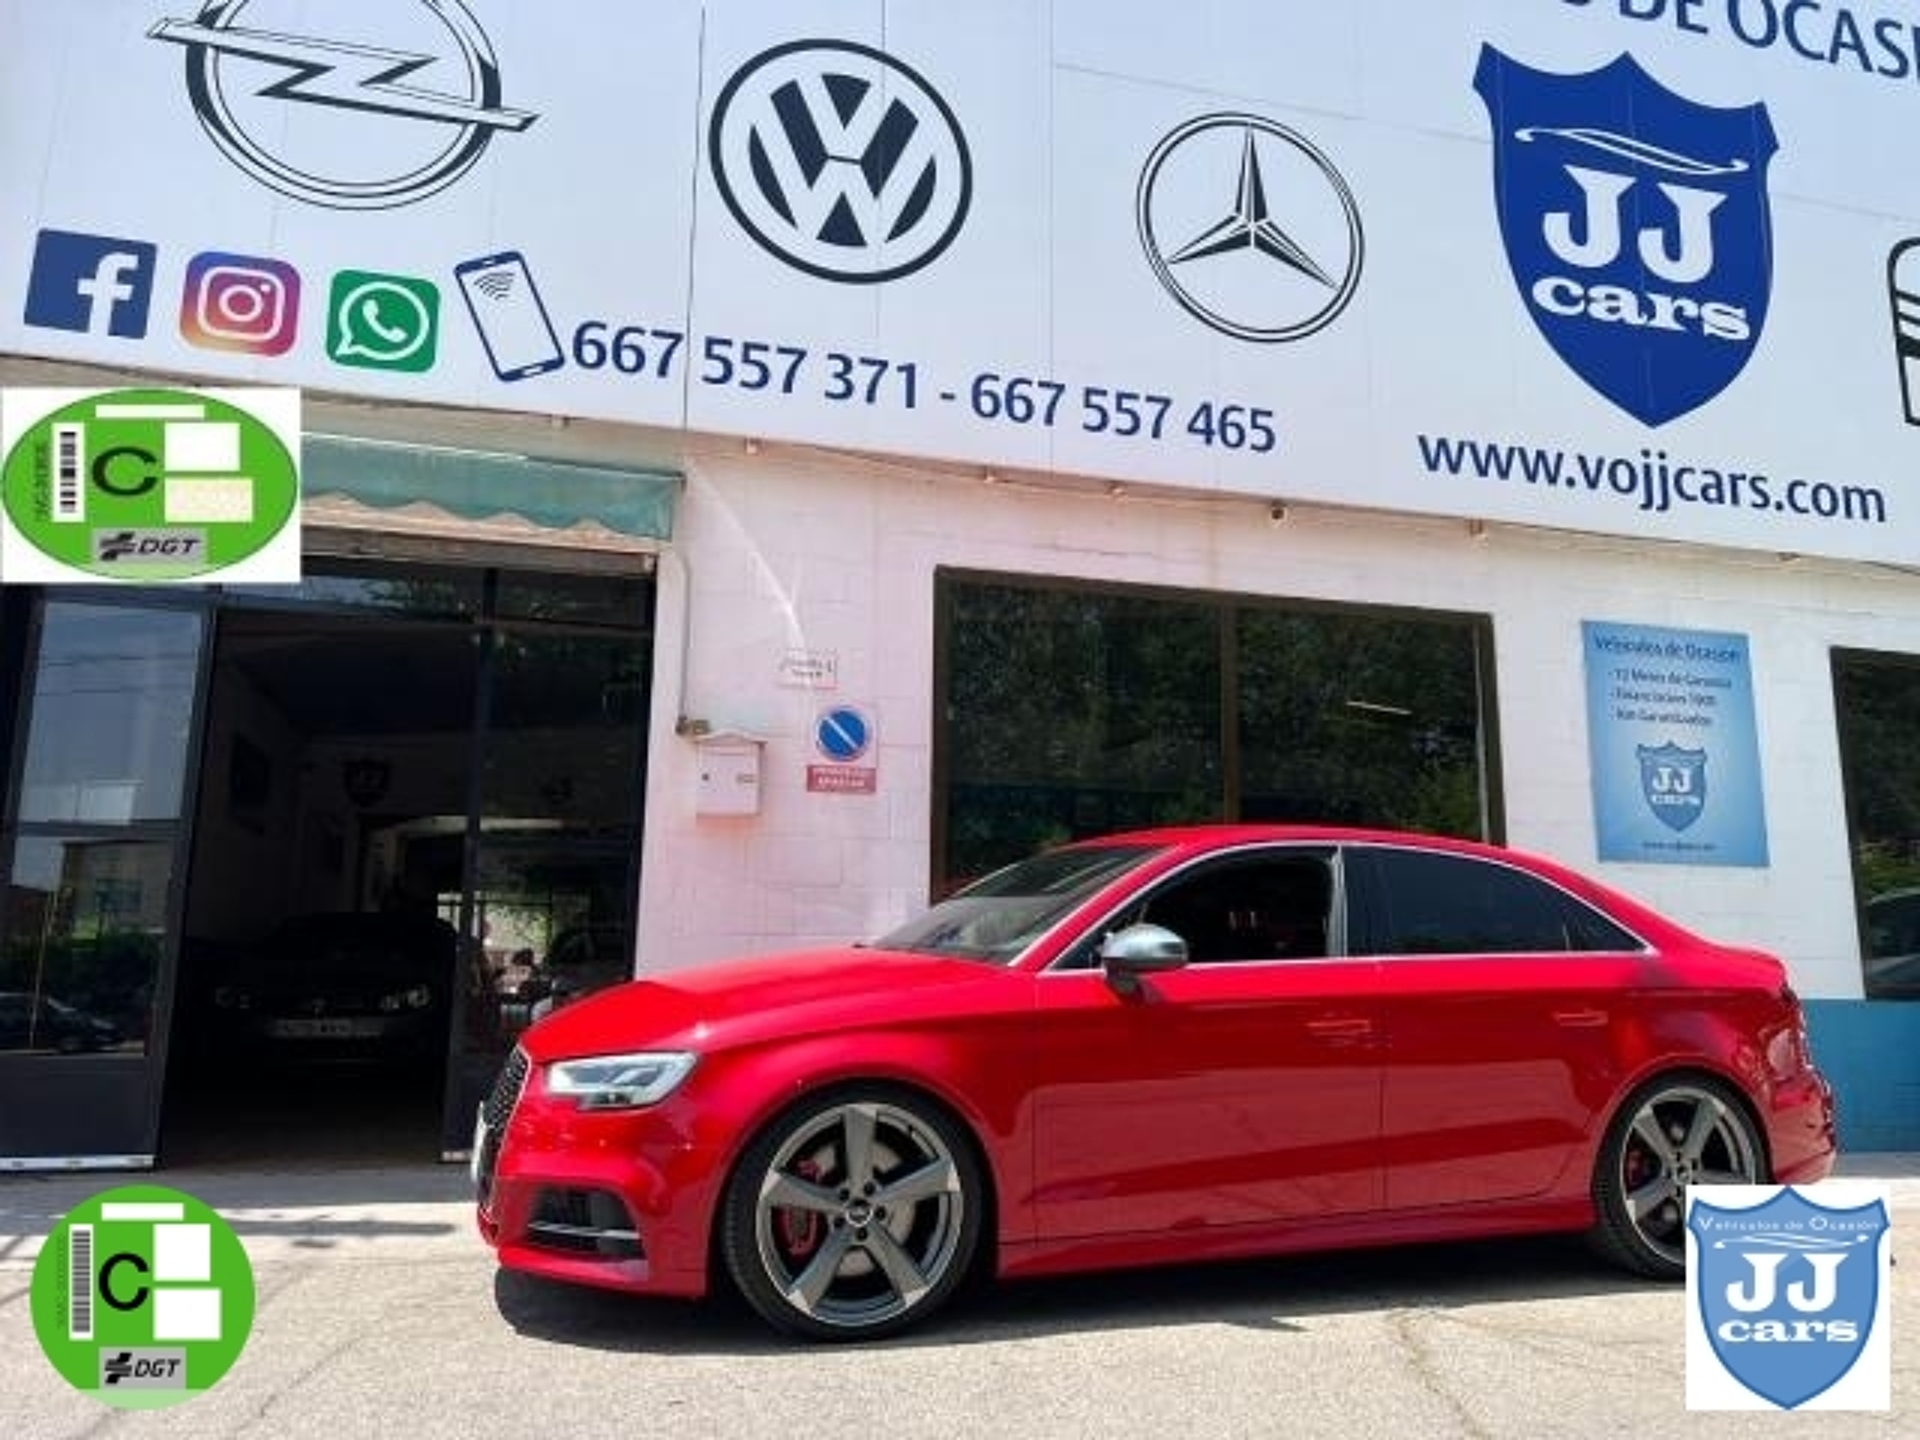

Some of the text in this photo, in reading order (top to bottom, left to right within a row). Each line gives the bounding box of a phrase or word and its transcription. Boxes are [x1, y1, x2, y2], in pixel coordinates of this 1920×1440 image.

[1542, 164, 1729, 283] JJ
[1531, 275, 1751, 341] cars
[572, 320, 684, 379] 667
[701, 336, 808, 394] 557
[824, 352, 916, 409] 371
[971, 373, 1066, 427] 667
[1082, 387, 1173, 439] 557
[1186, 402, 1276, 453] 465
[1418, 434, 1887, 522] www.vojjcars.com
[1652, 767, 1692, 793] JJ
